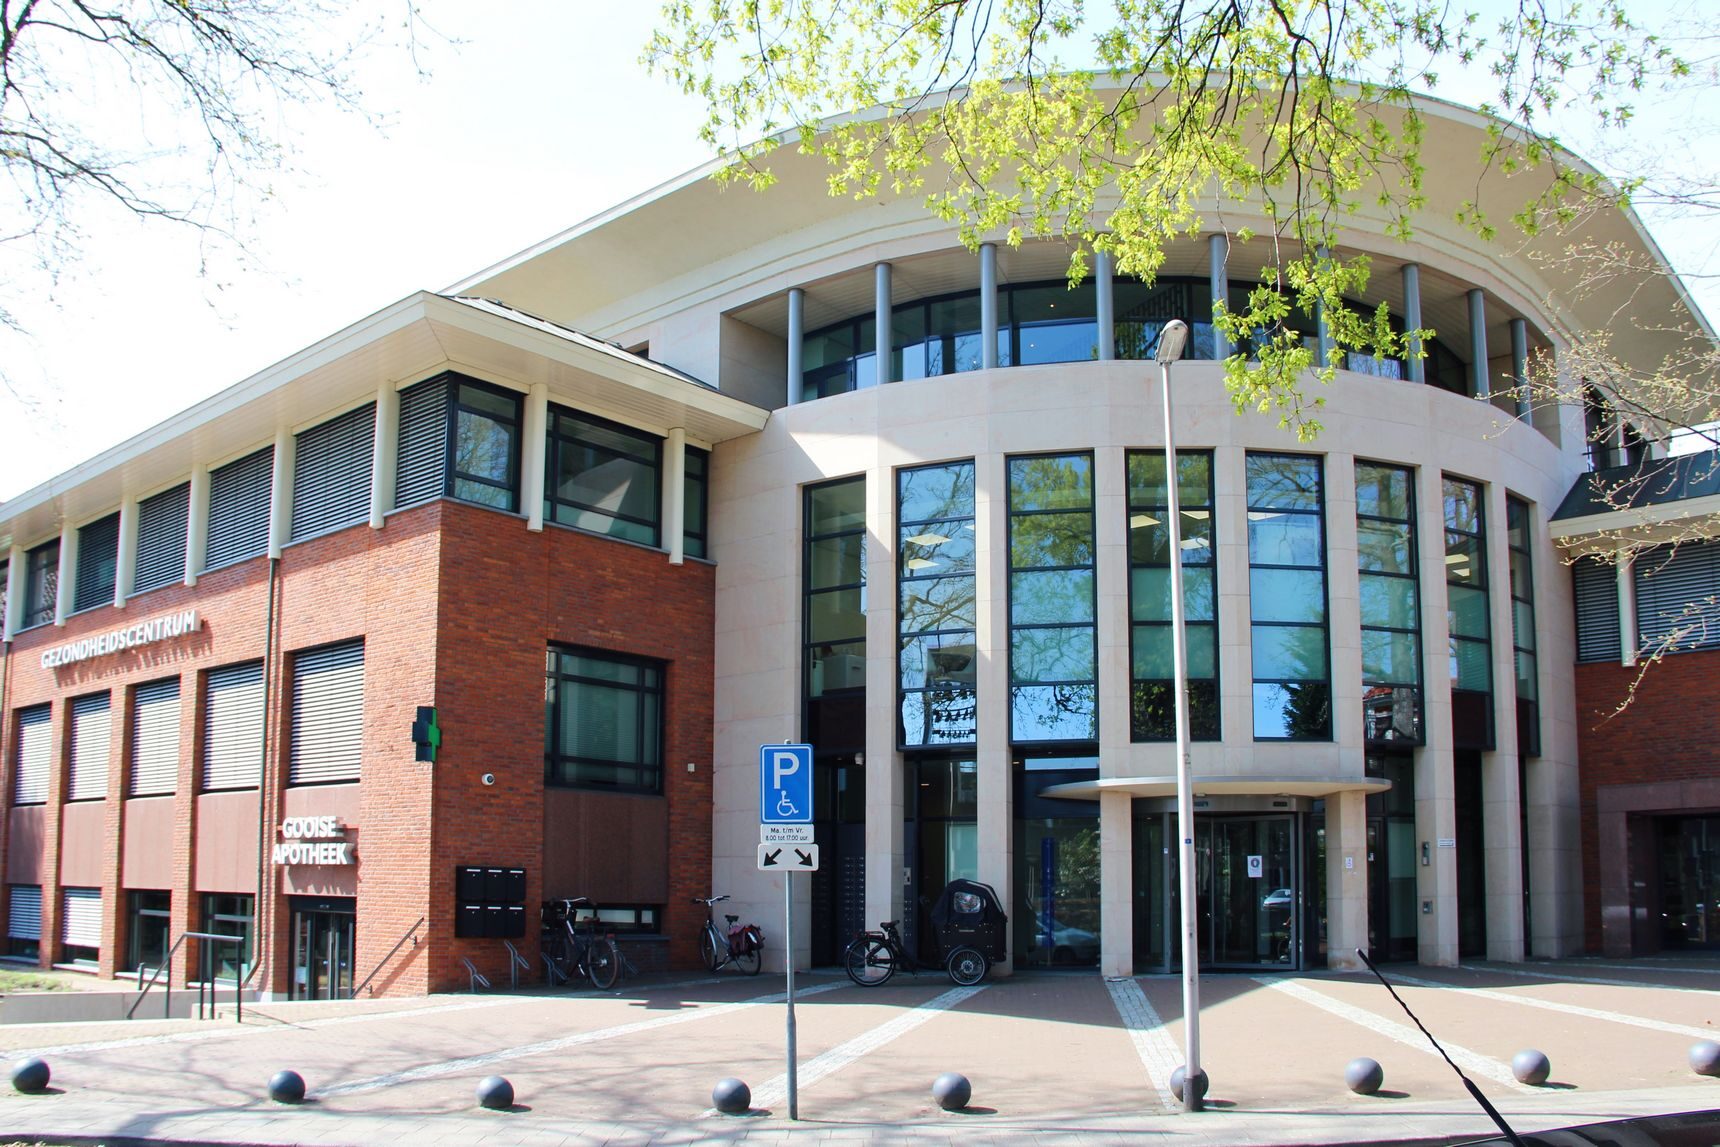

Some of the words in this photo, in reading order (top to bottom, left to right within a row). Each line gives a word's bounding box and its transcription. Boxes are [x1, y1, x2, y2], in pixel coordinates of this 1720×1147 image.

[41, 609, 197, 669] GEZONDHEIDSCENTRUM
[773, 752, 800, 789] P
[282, 816, 337, 838] GOOISE
[271, 843, 348, 865] APOTHEEK
